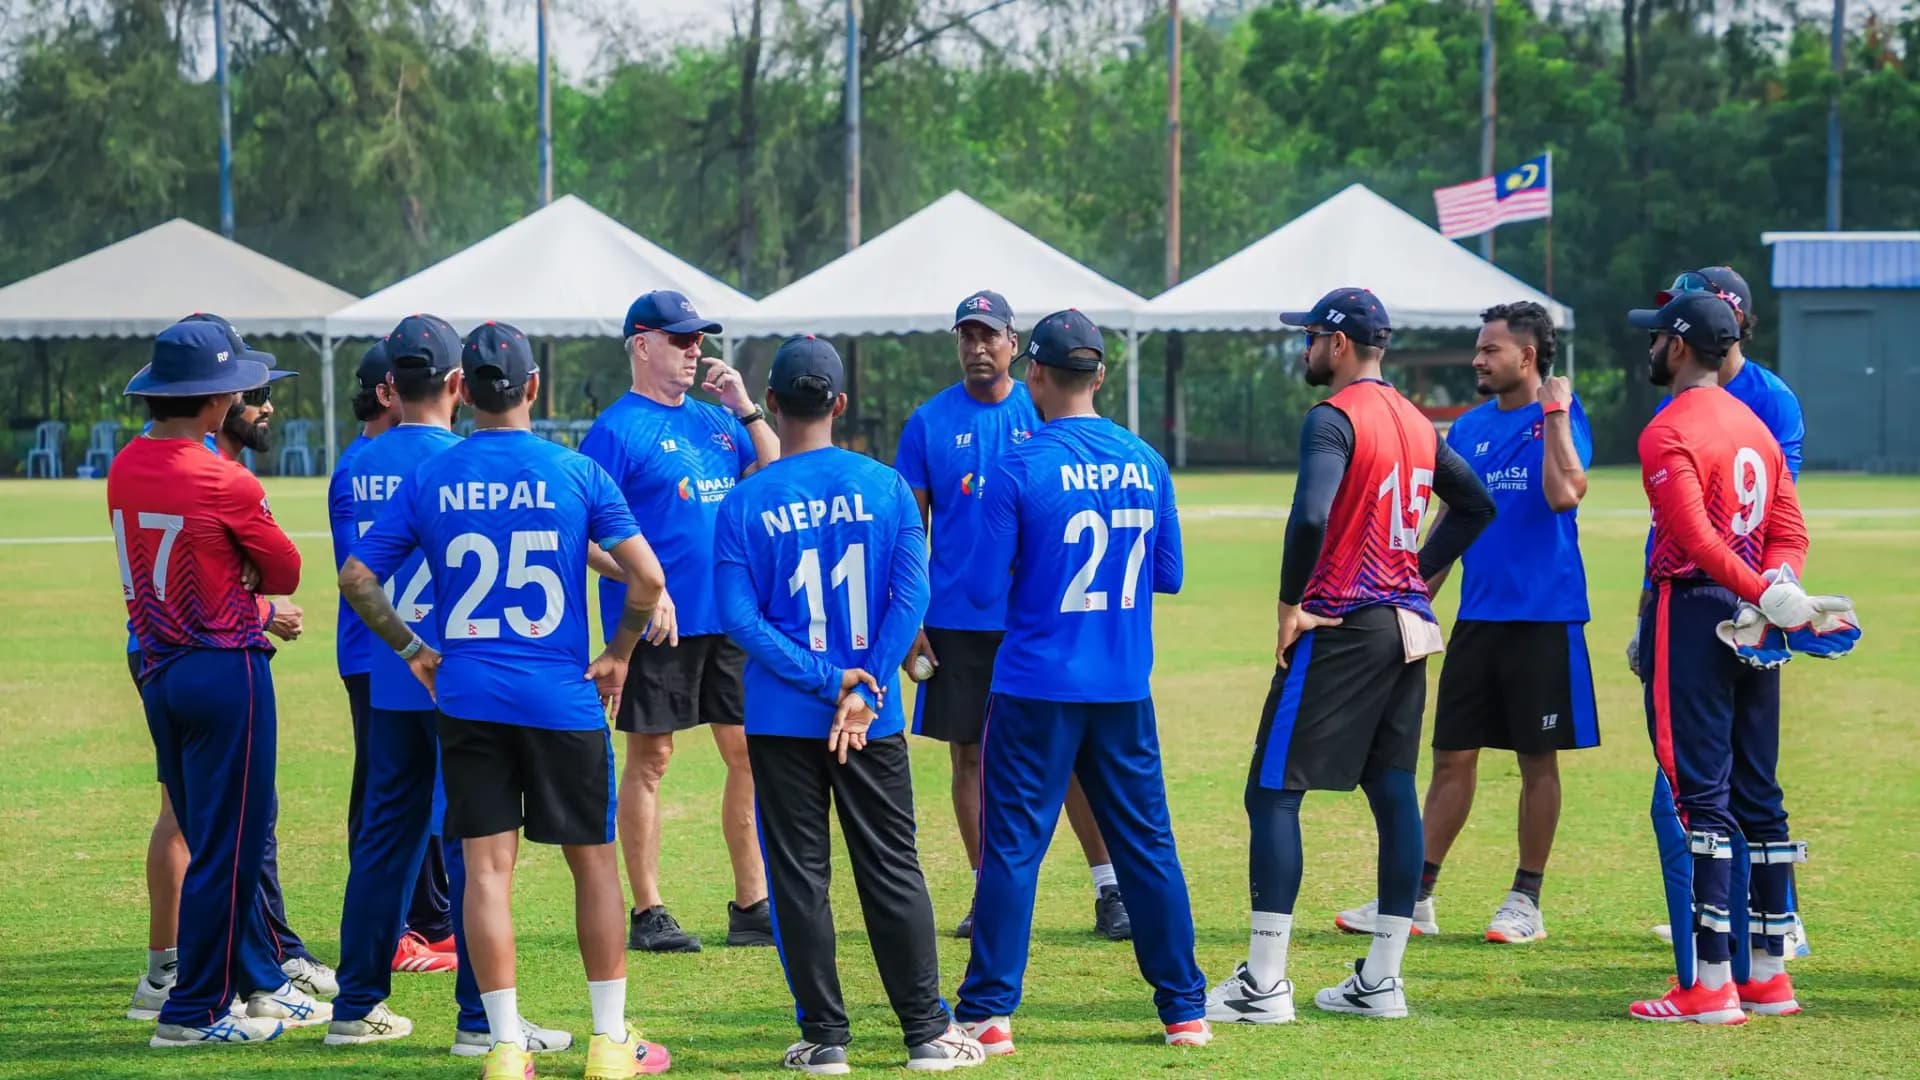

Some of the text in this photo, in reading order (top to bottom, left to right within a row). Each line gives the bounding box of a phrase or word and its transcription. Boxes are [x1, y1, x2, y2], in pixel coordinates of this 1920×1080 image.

[351, 475, 403, 501] NEP
[439, 480, 556, 513] NEPAL
[697, 477, 736, 491] NAASA
[761, 494, 873, 537] NEPAL
[1060, 463, 1155, 491] NEPAL
[1378, 462, 1434, 553] 15
[1731, 448, 1767, 536] 9
[112, 508, 184, 602] 17
[444, 530, 565, 640] 25
[788, 543, 869, 652] 11
[1060, 508, 1154, 613] 27
